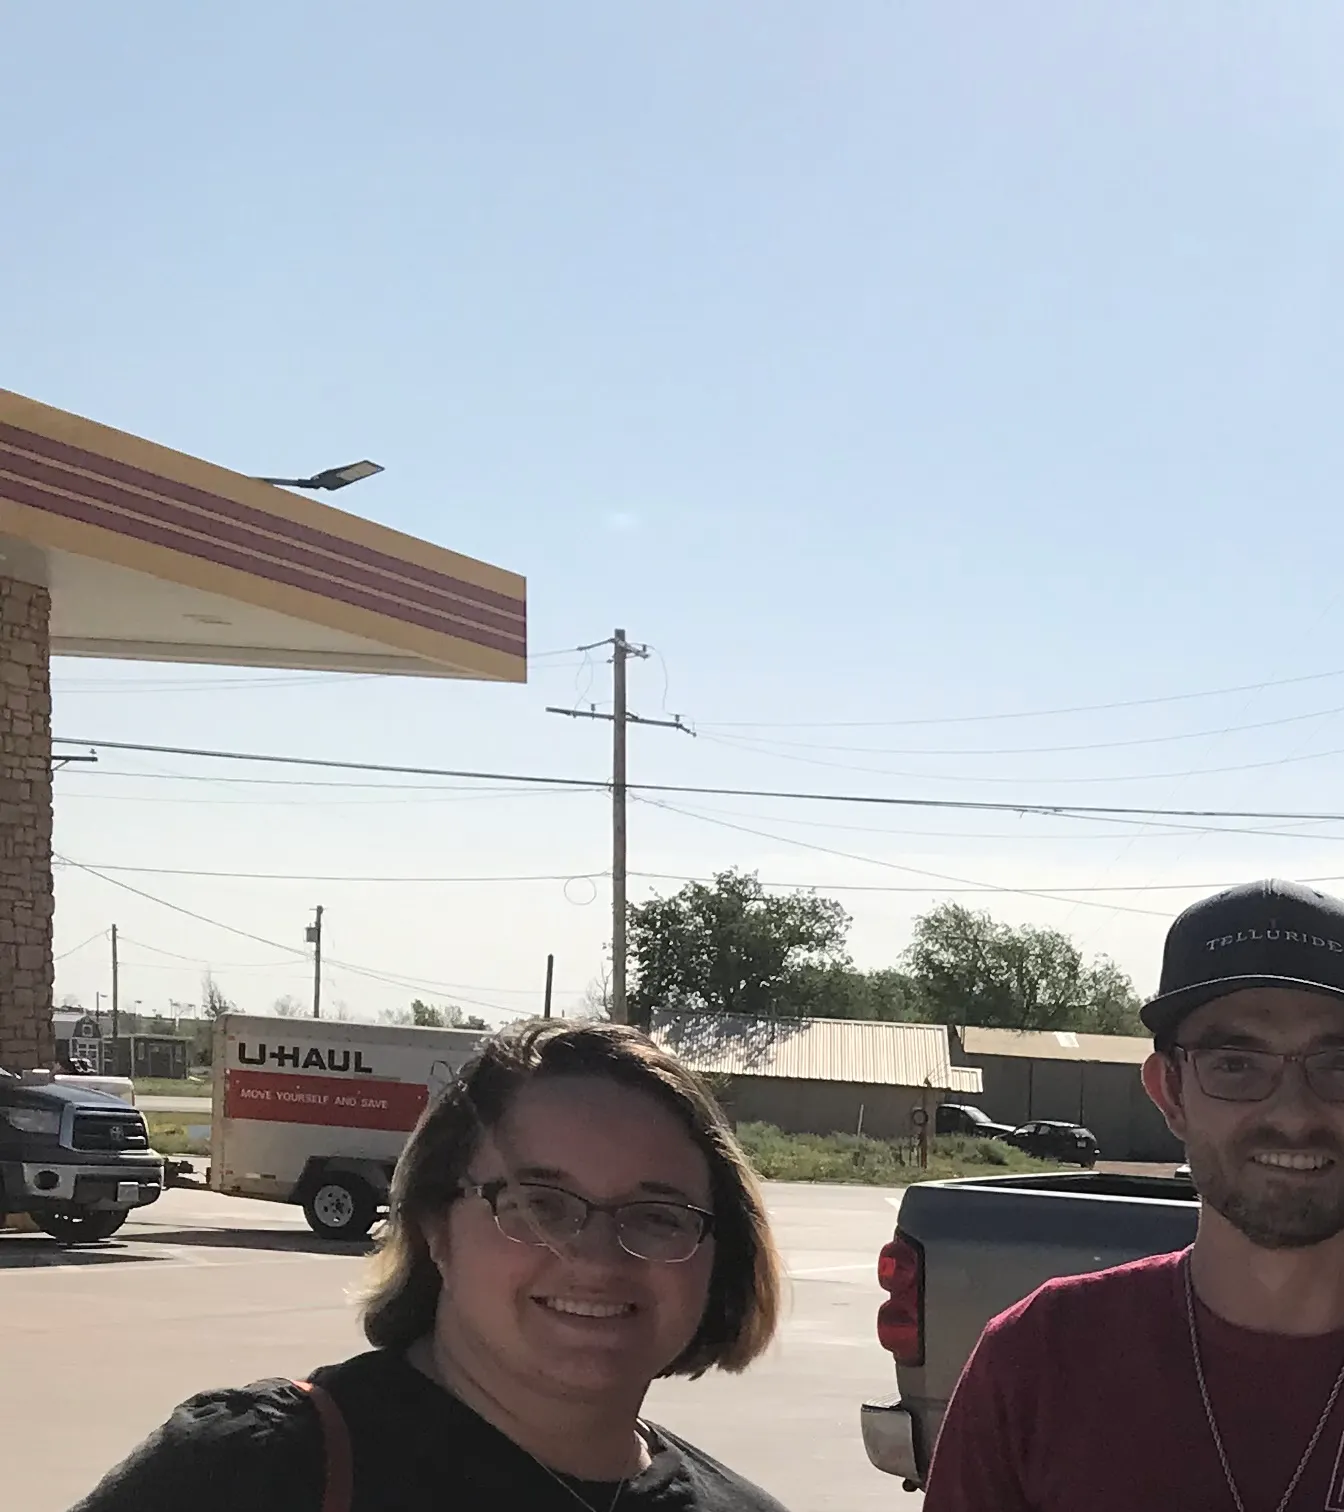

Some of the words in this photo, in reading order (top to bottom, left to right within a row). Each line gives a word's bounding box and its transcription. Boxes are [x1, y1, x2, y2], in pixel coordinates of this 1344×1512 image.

[1205, 928, 1344, 953] TELLURIDE
[238, 1042, 373, 1074] U-HAUL
[240, 1088, 271, 1101] MOVE
[276, 1091, 329, 1104] YOURSELF
[334, 1095, 356, 1107] AND
[361, 1098, 388, 1110] SAVE
